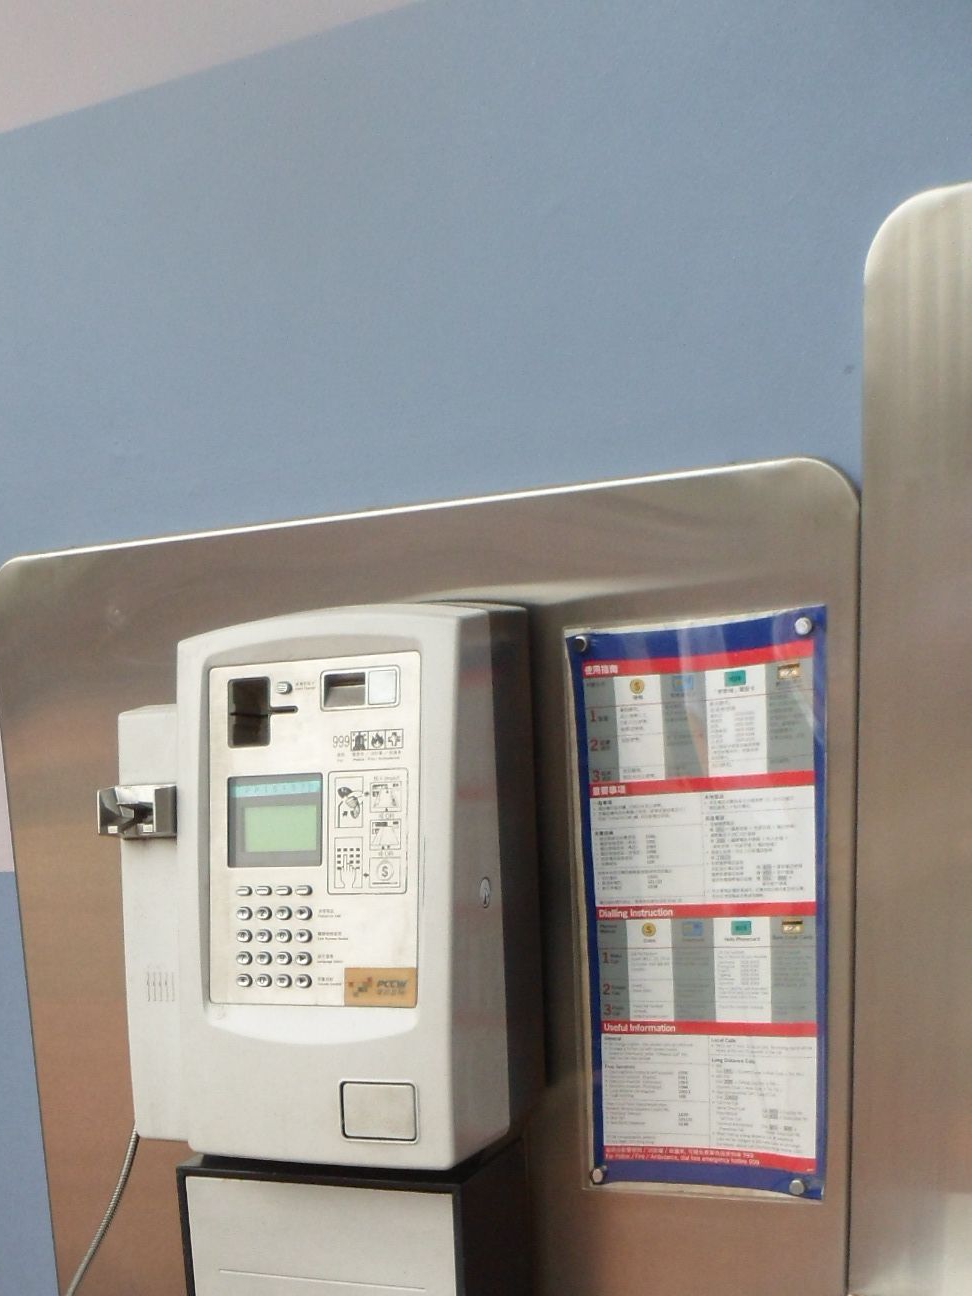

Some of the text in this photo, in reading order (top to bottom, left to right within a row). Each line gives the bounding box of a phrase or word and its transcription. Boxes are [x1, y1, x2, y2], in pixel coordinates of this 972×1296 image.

[332, 734, 351, 749] 999
[598, 907, 674, 919] Dialling Instruction
[603, 951, 609, 964] 1
[603, 983, 611, 995] 2
[604, 1003, 613, 1016] 3
[603, 1022, 676, 1033] Useful Information
